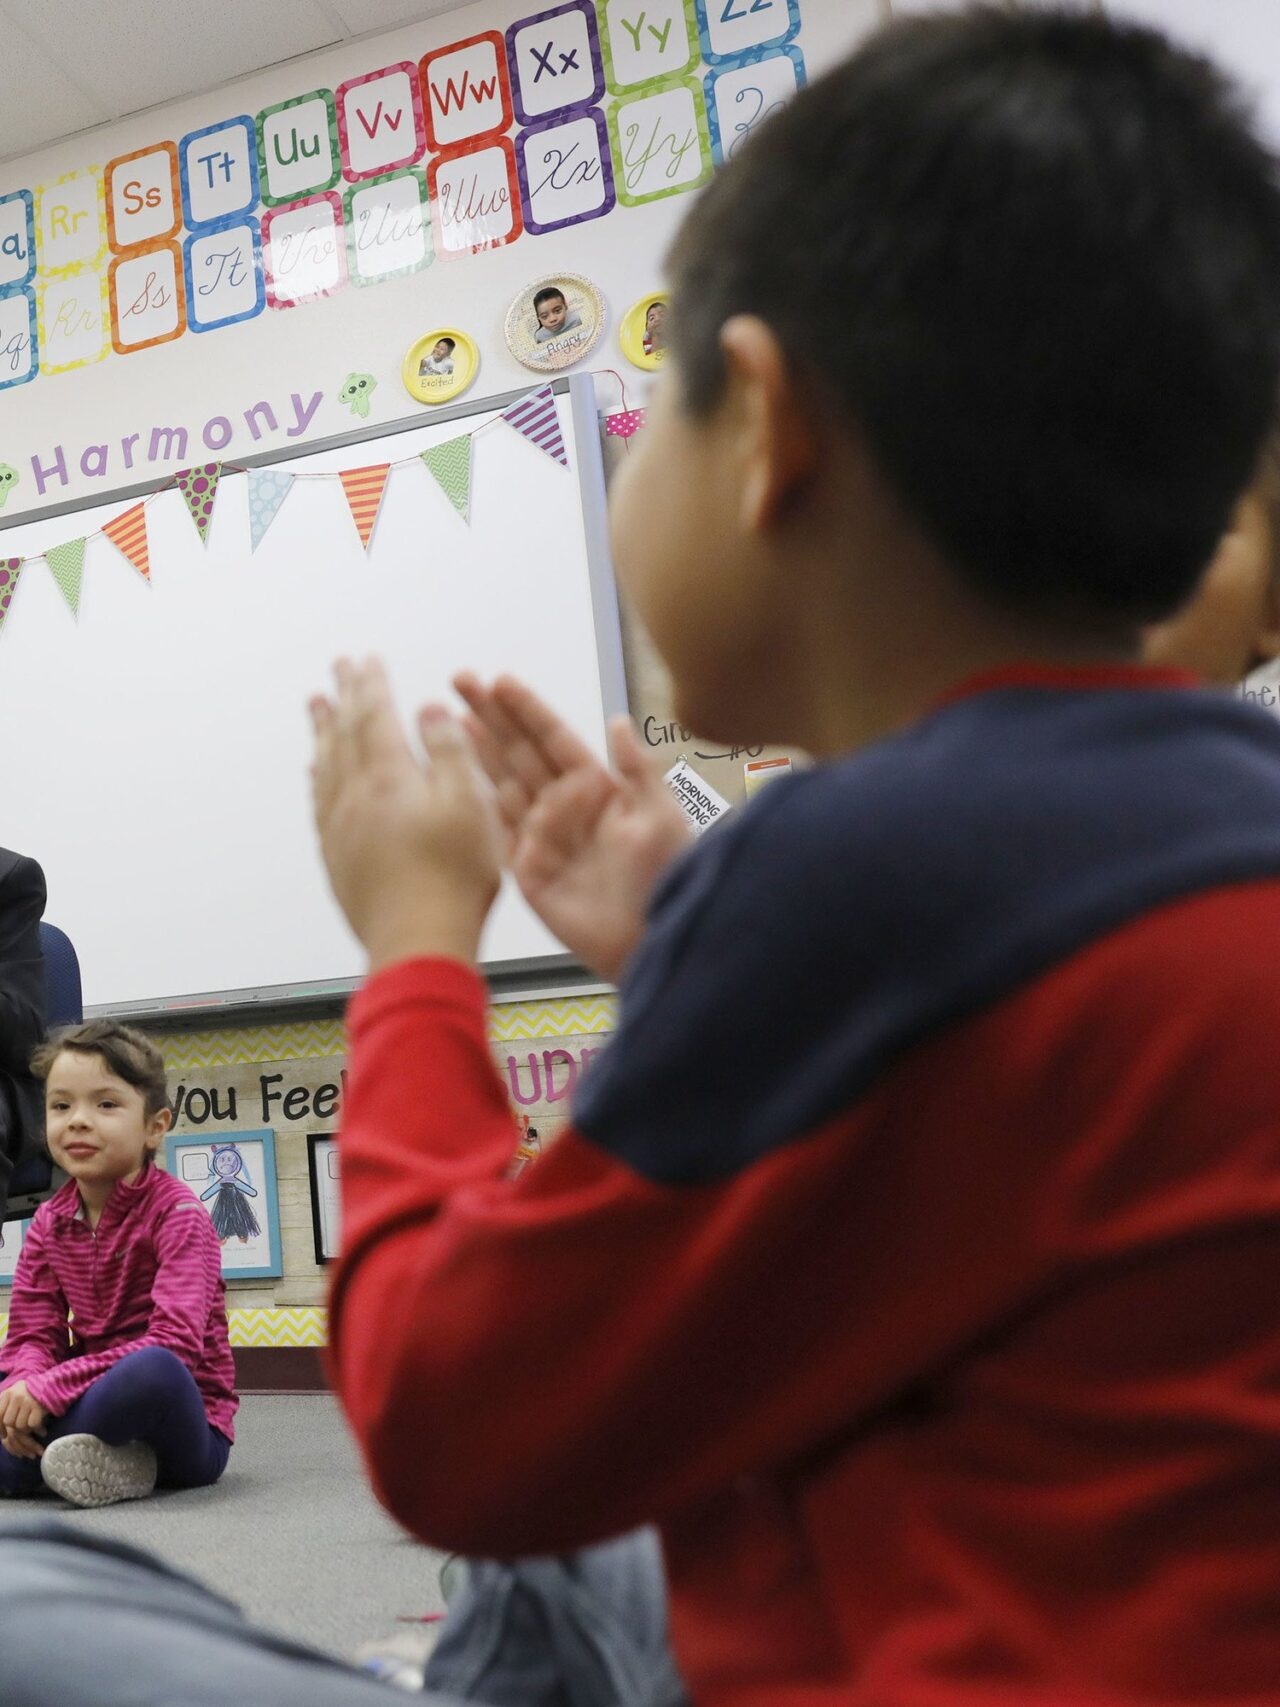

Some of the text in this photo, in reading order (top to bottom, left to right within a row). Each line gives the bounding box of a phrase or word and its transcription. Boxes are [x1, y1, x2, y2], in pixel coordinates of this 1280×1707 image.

[50, 205, 89, 240] Rr
[123, 181, 161, 215] Ss
[197, 151, 235, 188] Tt
[274, 128, 320, 166] Uu
[356, 101, 402, 139] Vv
[431, 70, 496, 116] Ww
[530, 41, 579, 83] Xx
[621, 11, 672, 53] Yy
[546, 333, 582, 356] Angry
[30, 391, 324, 495] Harmony
[673, 772, 720, 817] MORNING
